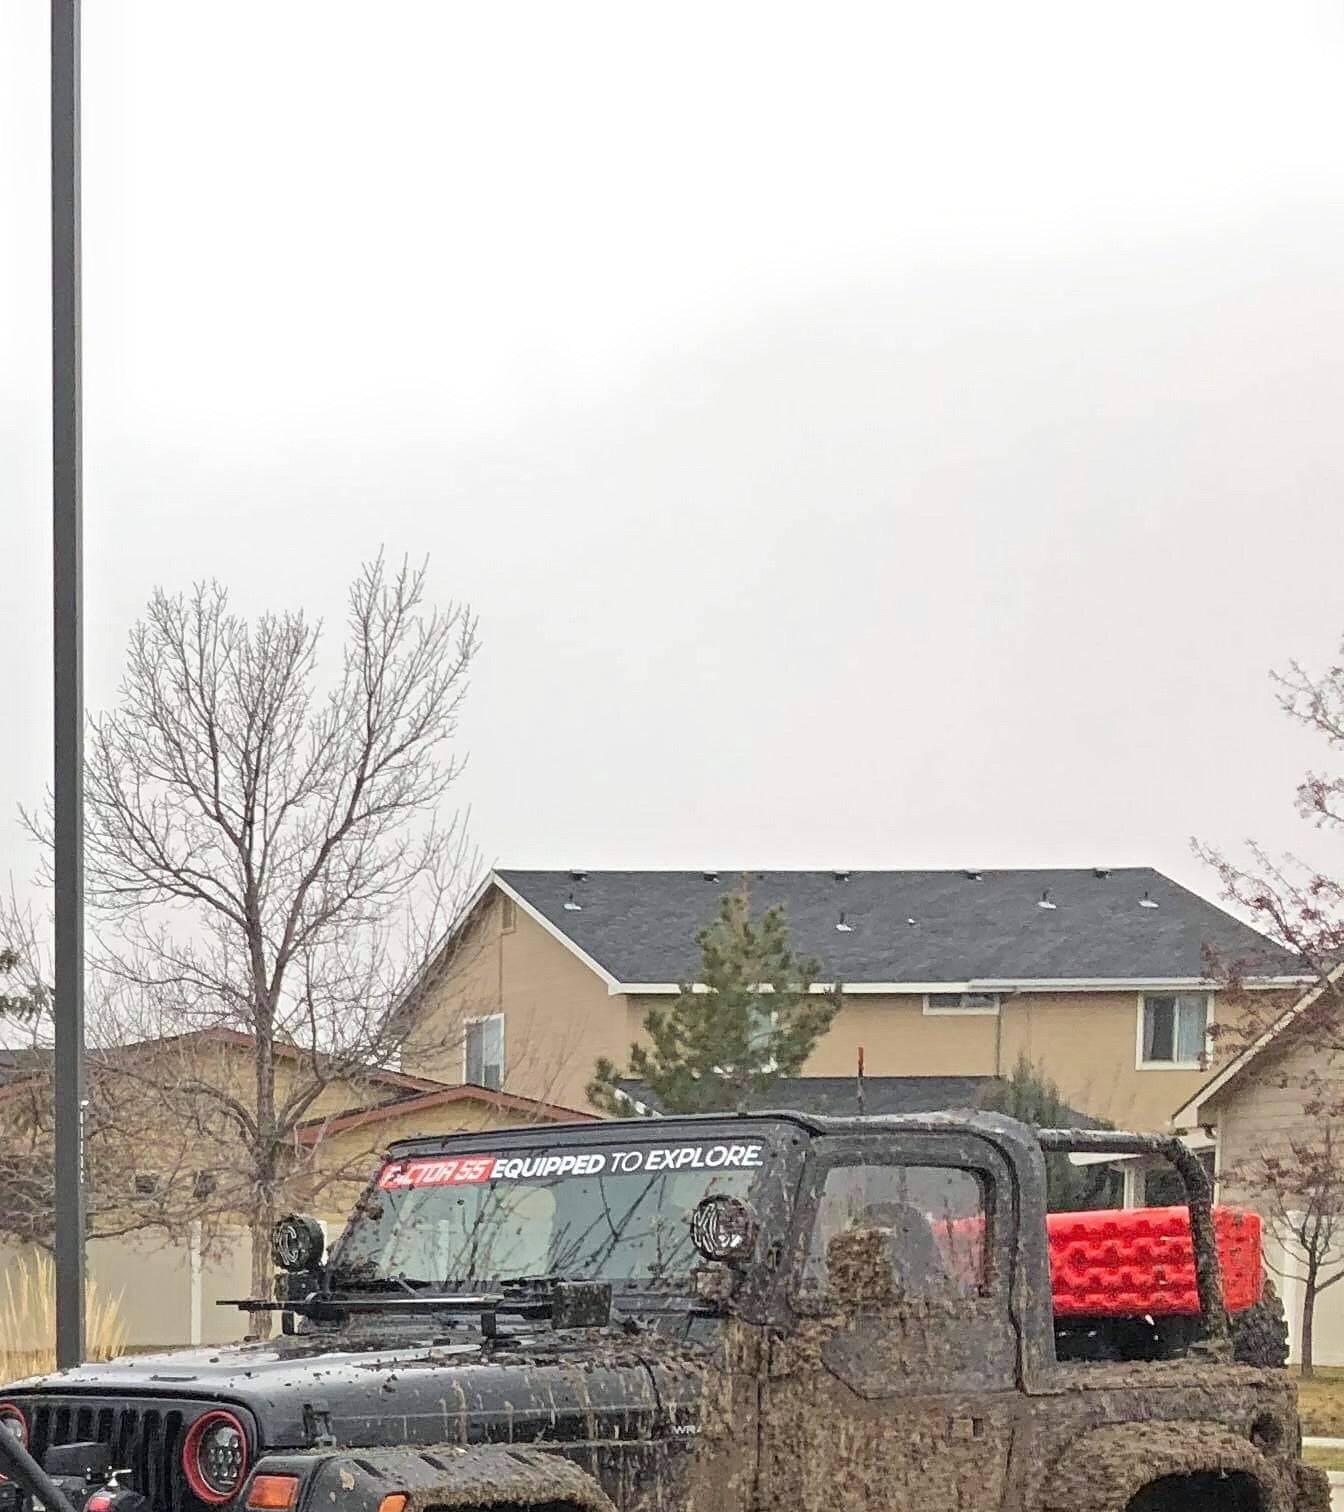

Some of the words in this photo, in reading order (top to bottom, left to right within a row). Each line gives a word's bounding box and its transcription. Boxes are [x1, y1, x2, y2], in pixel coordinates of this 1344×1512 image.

[454, 1159, 494, 1181] 55
[490, 1152, 606, 1179] EQUIPPED
[611, 1151, 644, 1173] TO
